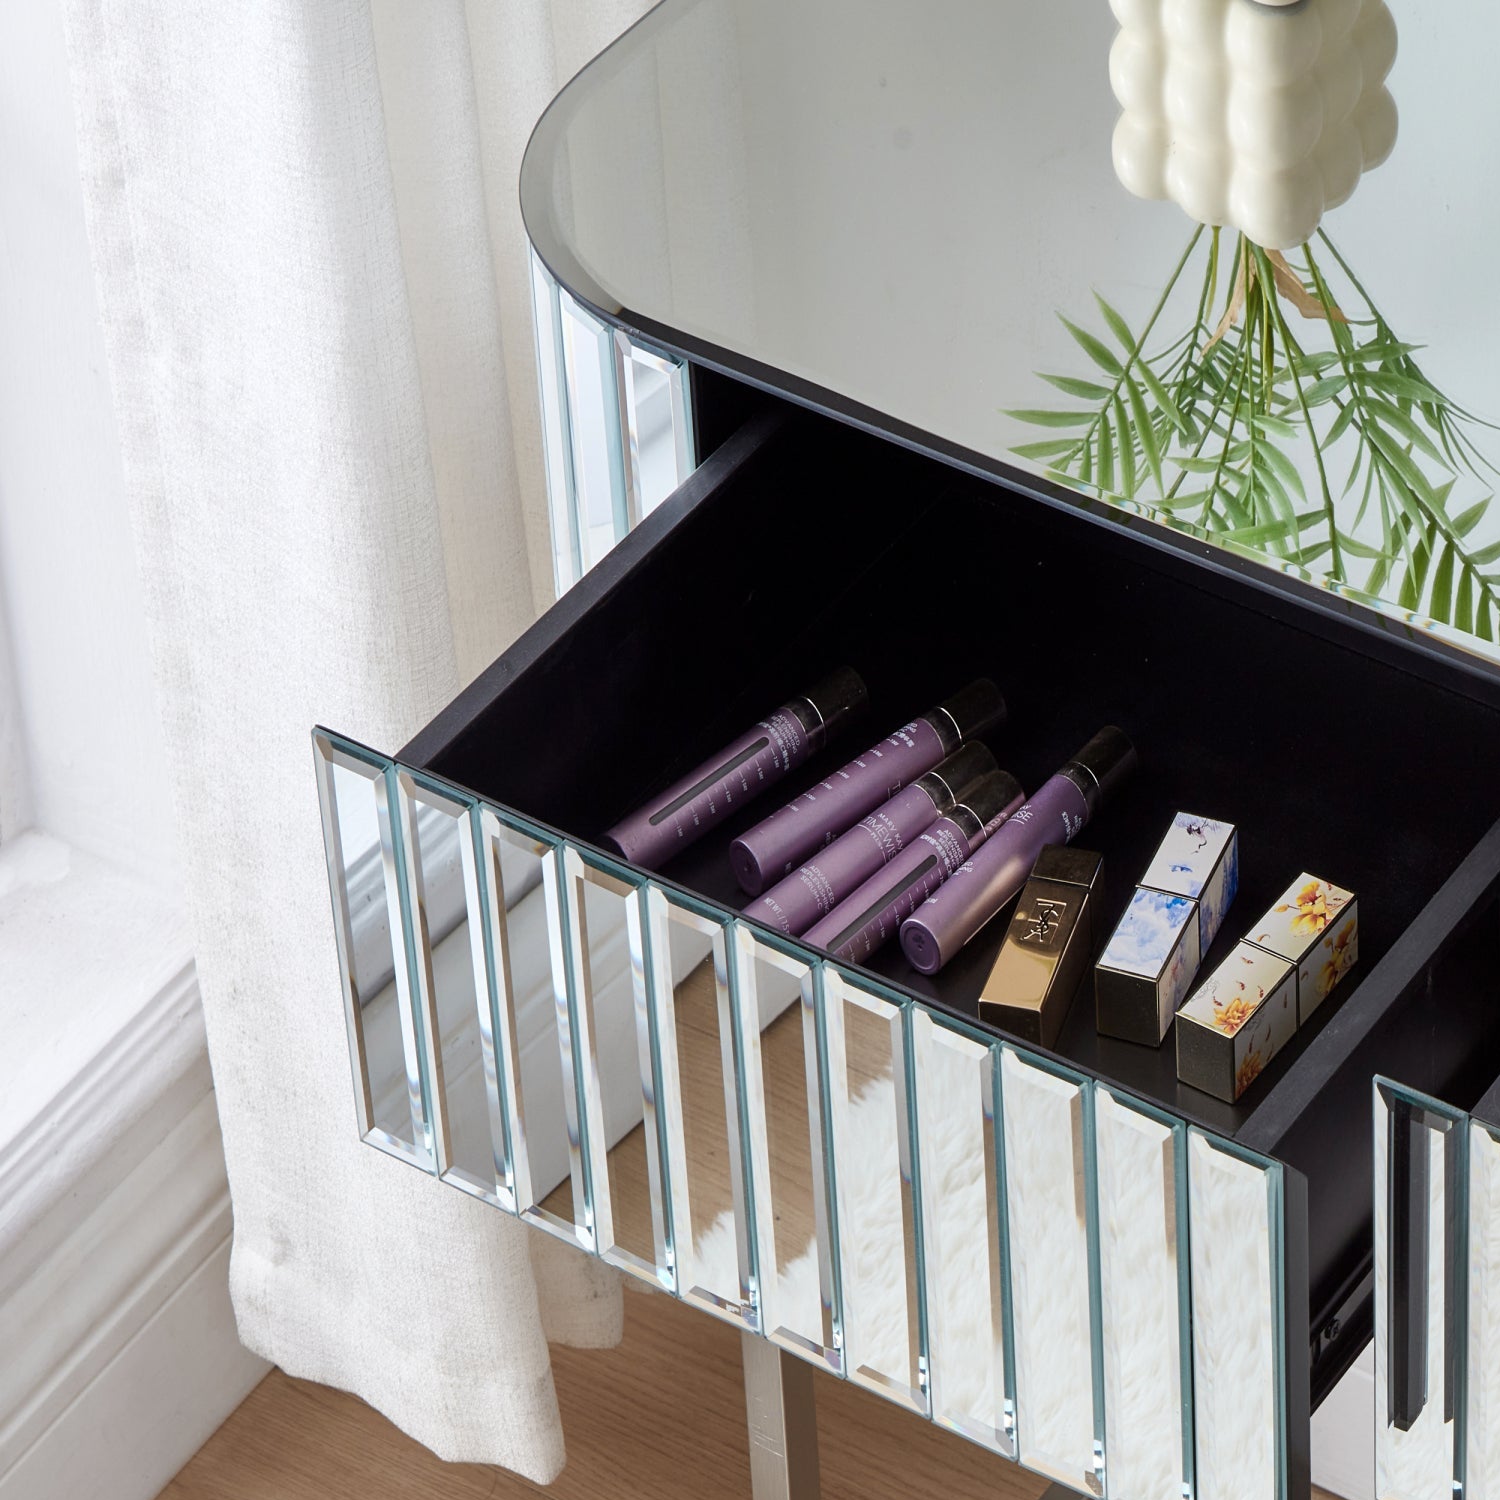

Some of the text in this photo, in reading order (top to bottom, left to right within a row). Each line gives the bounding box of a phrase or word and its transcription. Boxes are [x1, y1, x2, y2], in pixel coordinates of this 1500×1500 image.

[863, 816, 897, 860] TIMEWIS
[877, 813, 897, 831] MARY
[894, 833, 903, 850] KAY
[808, 865, 834, 904] ADVANCED
